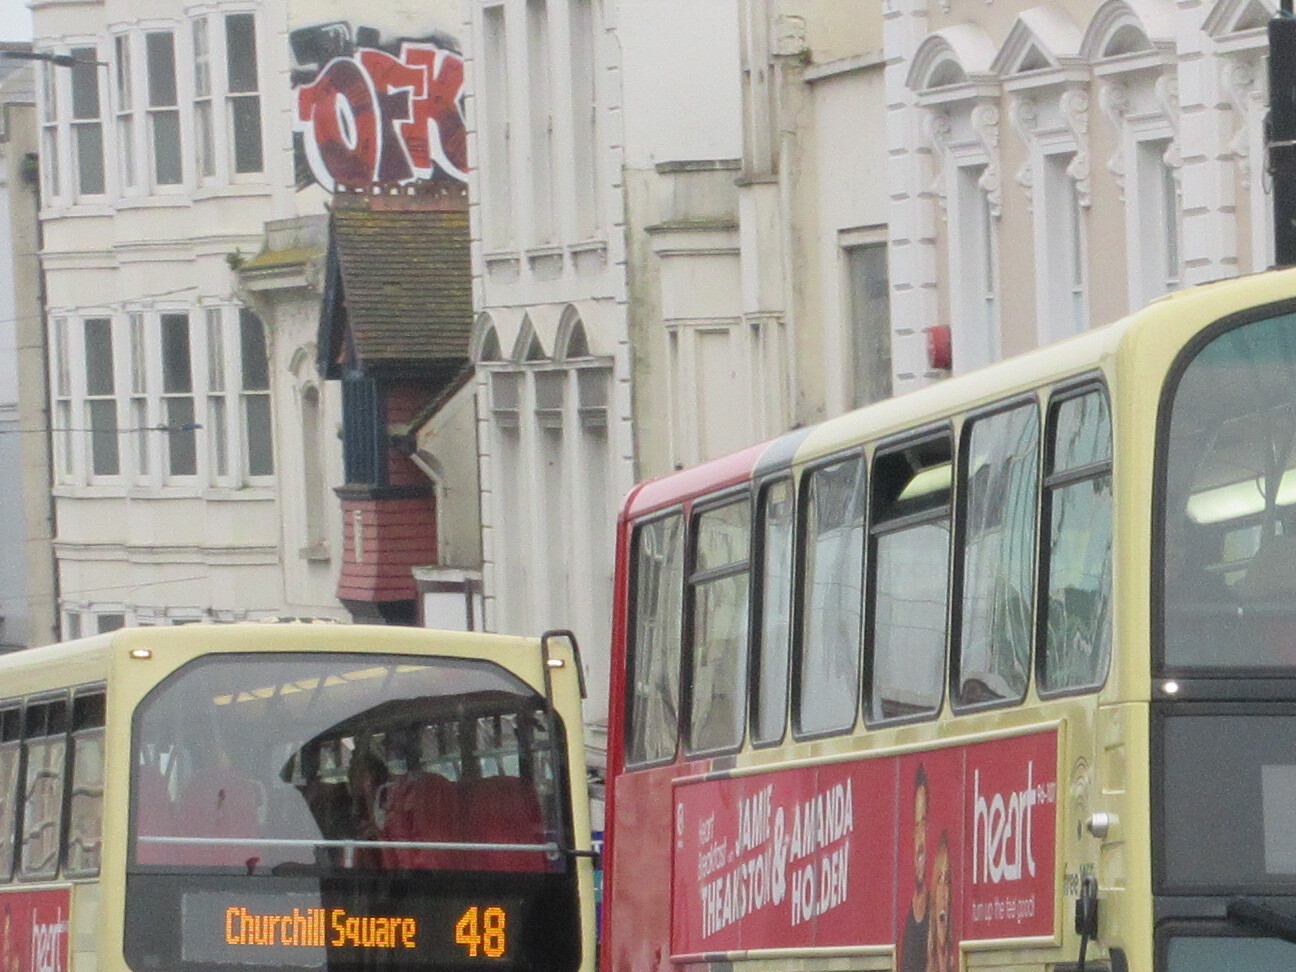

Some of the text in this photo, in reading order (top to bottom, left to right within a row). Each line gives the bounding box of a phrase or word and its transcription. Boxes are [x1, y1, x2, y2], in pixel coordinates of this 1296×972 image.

[736, 784, 773, 858] JAMIE
[772, 806, 787, 906] &
[789, 777, 854, 863] AMANDA
[972, 760, 1036, 884] heart
[225, 906, 507, 957] Churchill Square 48
